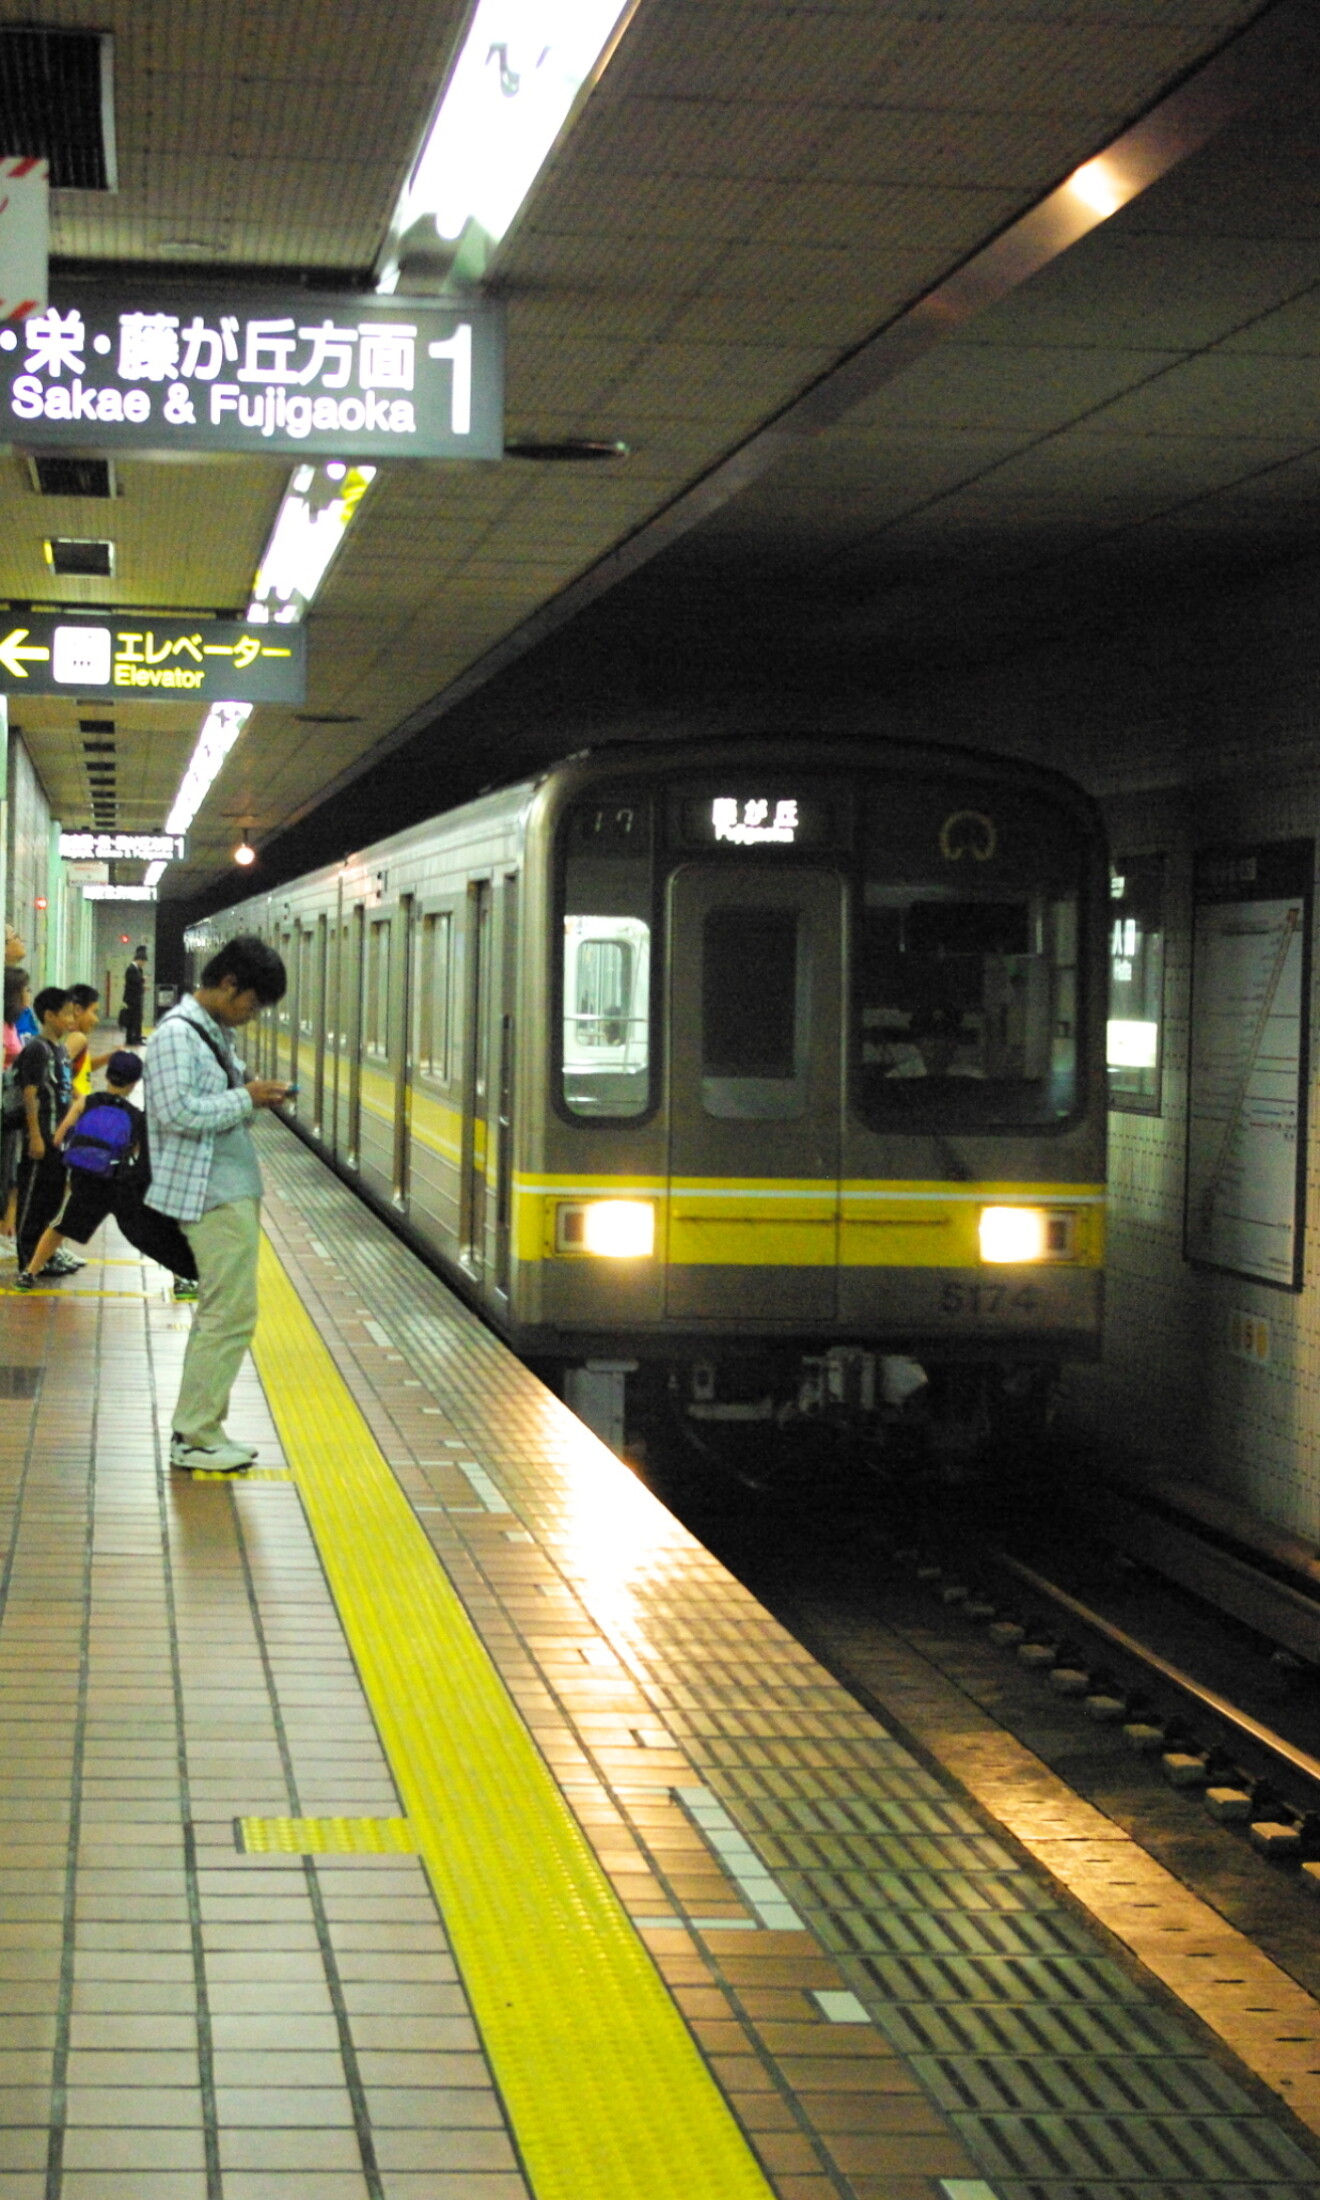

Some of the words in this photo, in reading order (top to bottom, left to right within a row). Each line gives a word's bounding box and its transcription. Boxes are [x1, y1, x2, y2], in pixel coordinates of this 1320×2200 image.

[428, 324, 472, 435] 1
[11, 375, 151, 423] Sakae
[163, 382, 197, 424] &
[210, 383, 417, 438] Fujigaoka
[114, 631, 292, 669] エレベーター
[114, 663, 205, 689] Elevator
